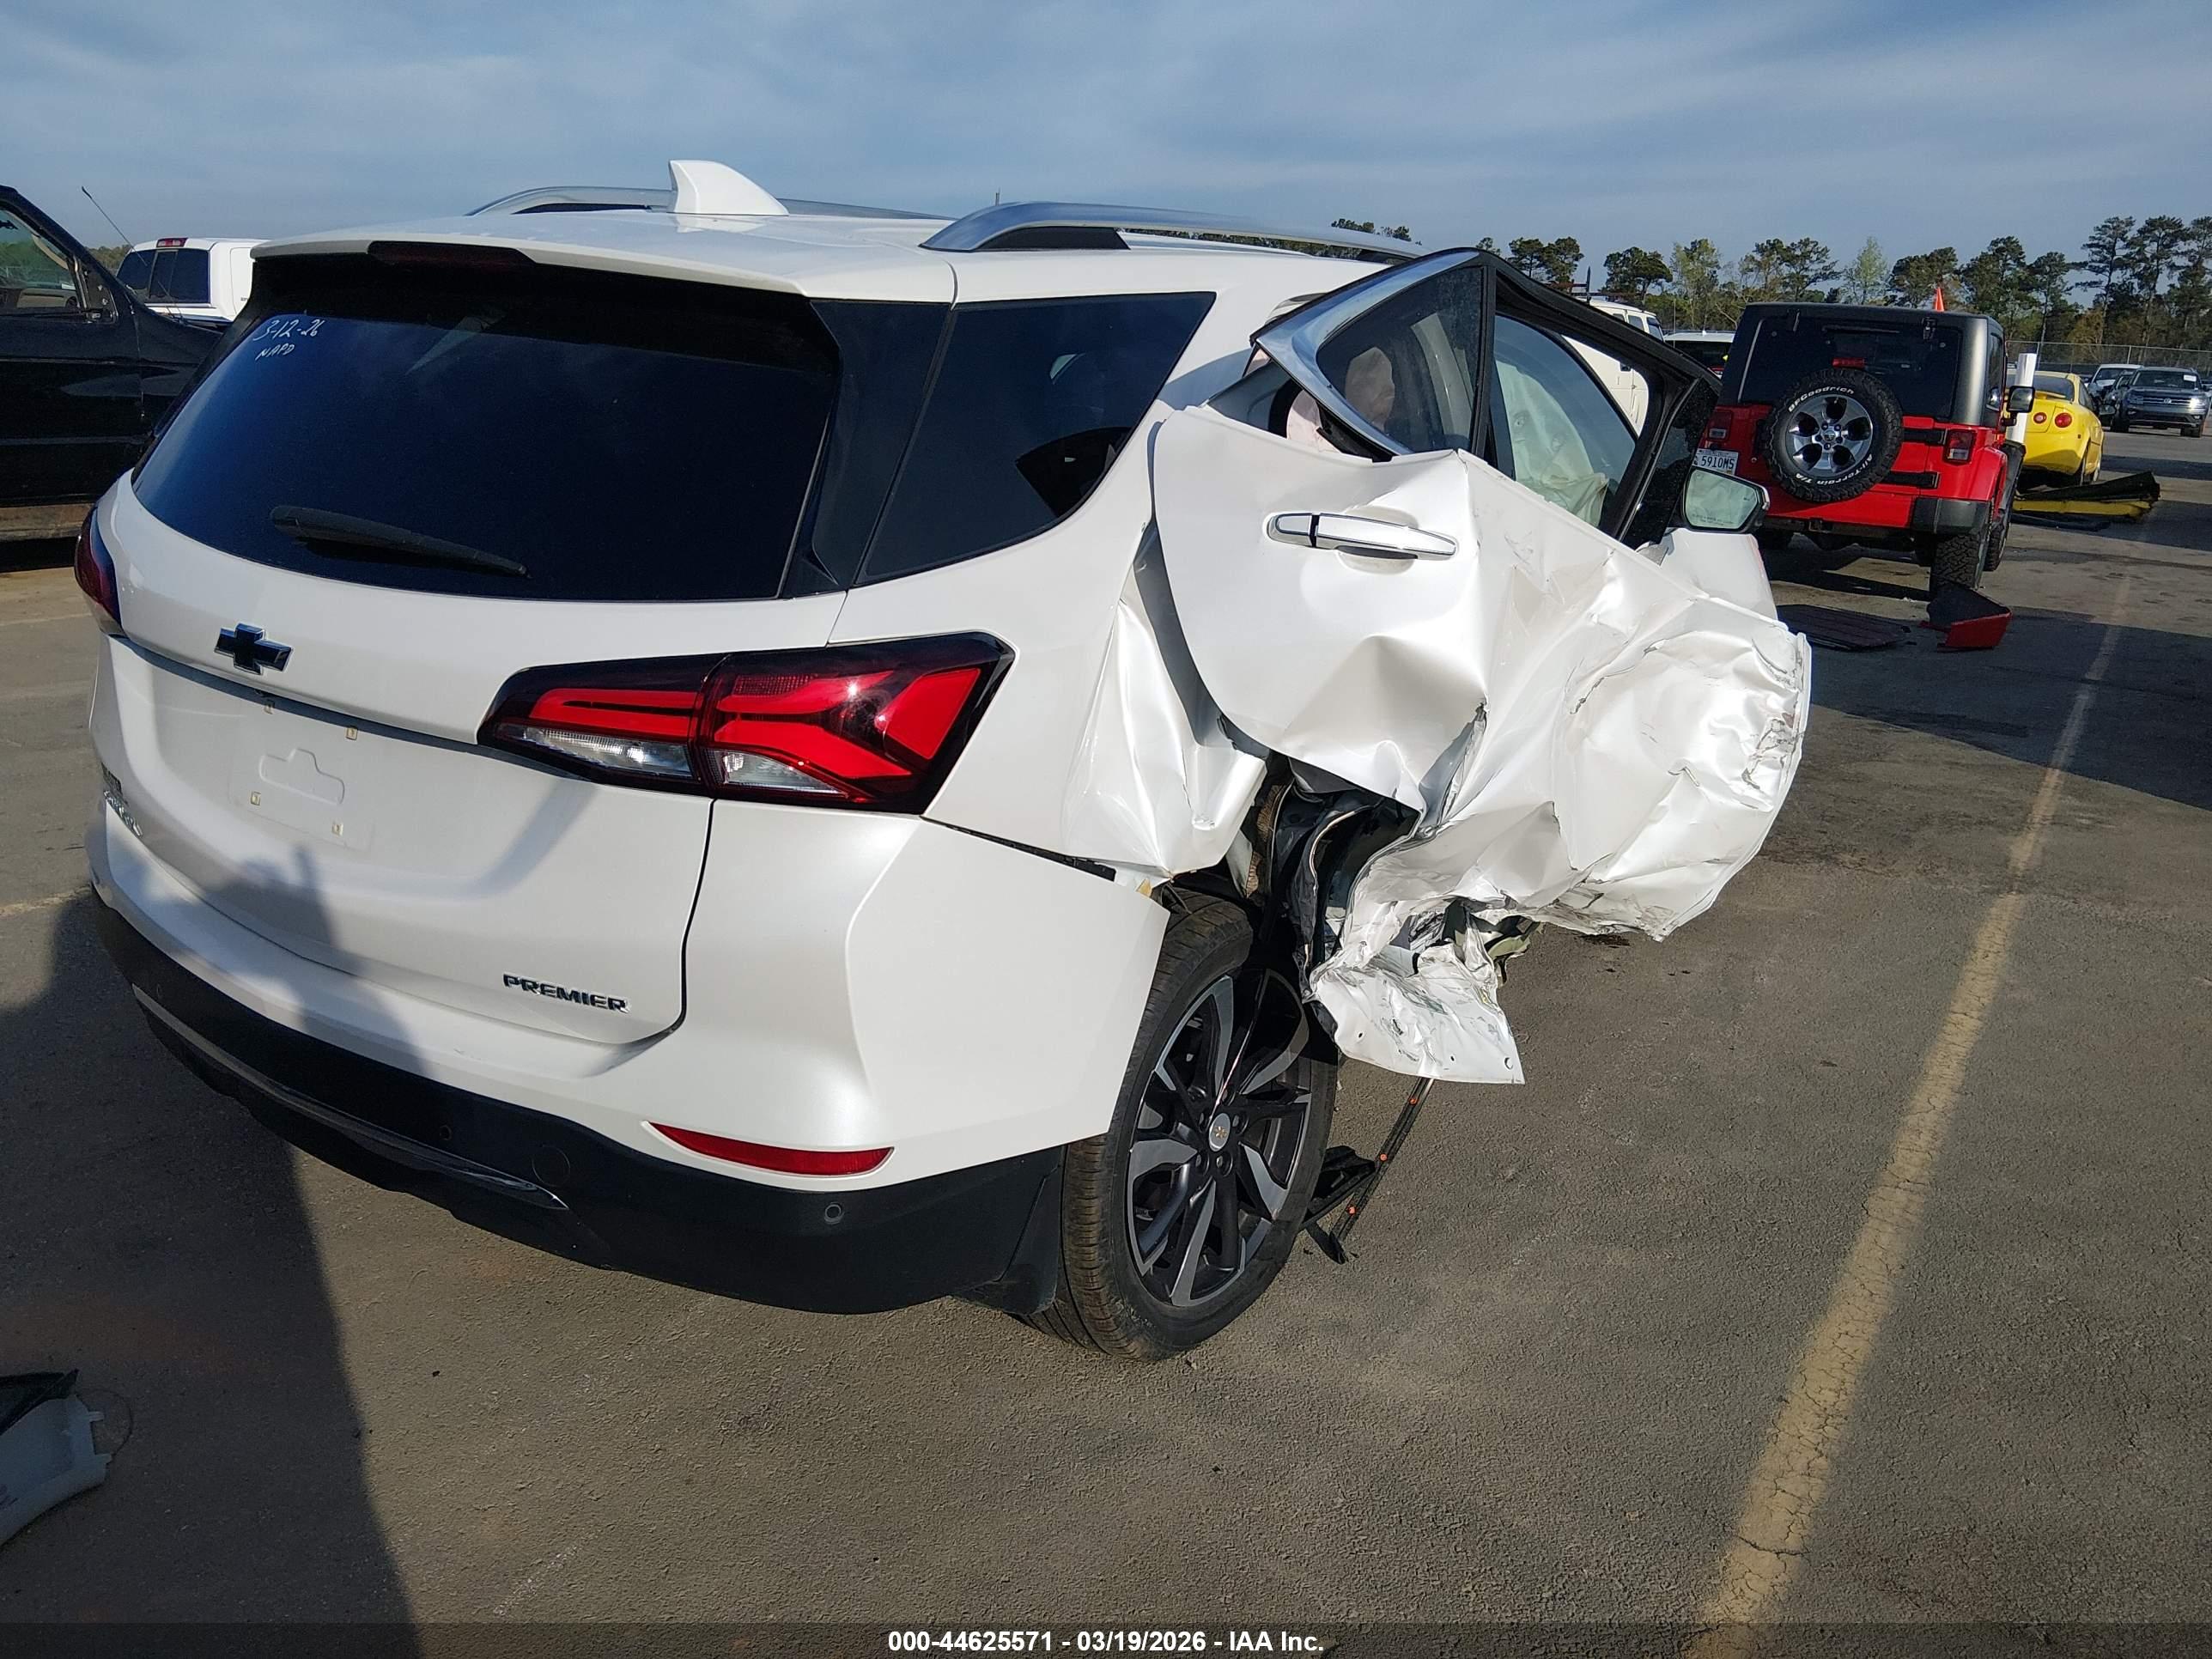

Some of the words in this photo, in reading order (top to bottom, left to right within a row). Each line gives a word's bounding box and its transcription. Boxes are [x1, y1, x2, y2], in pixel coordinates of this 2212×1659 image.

[252, 319, 325, 341] 3-12-26
[1788, 386, 1855, 412] BFGoodrich
[503, 972, 631, 1014] PREMIER
